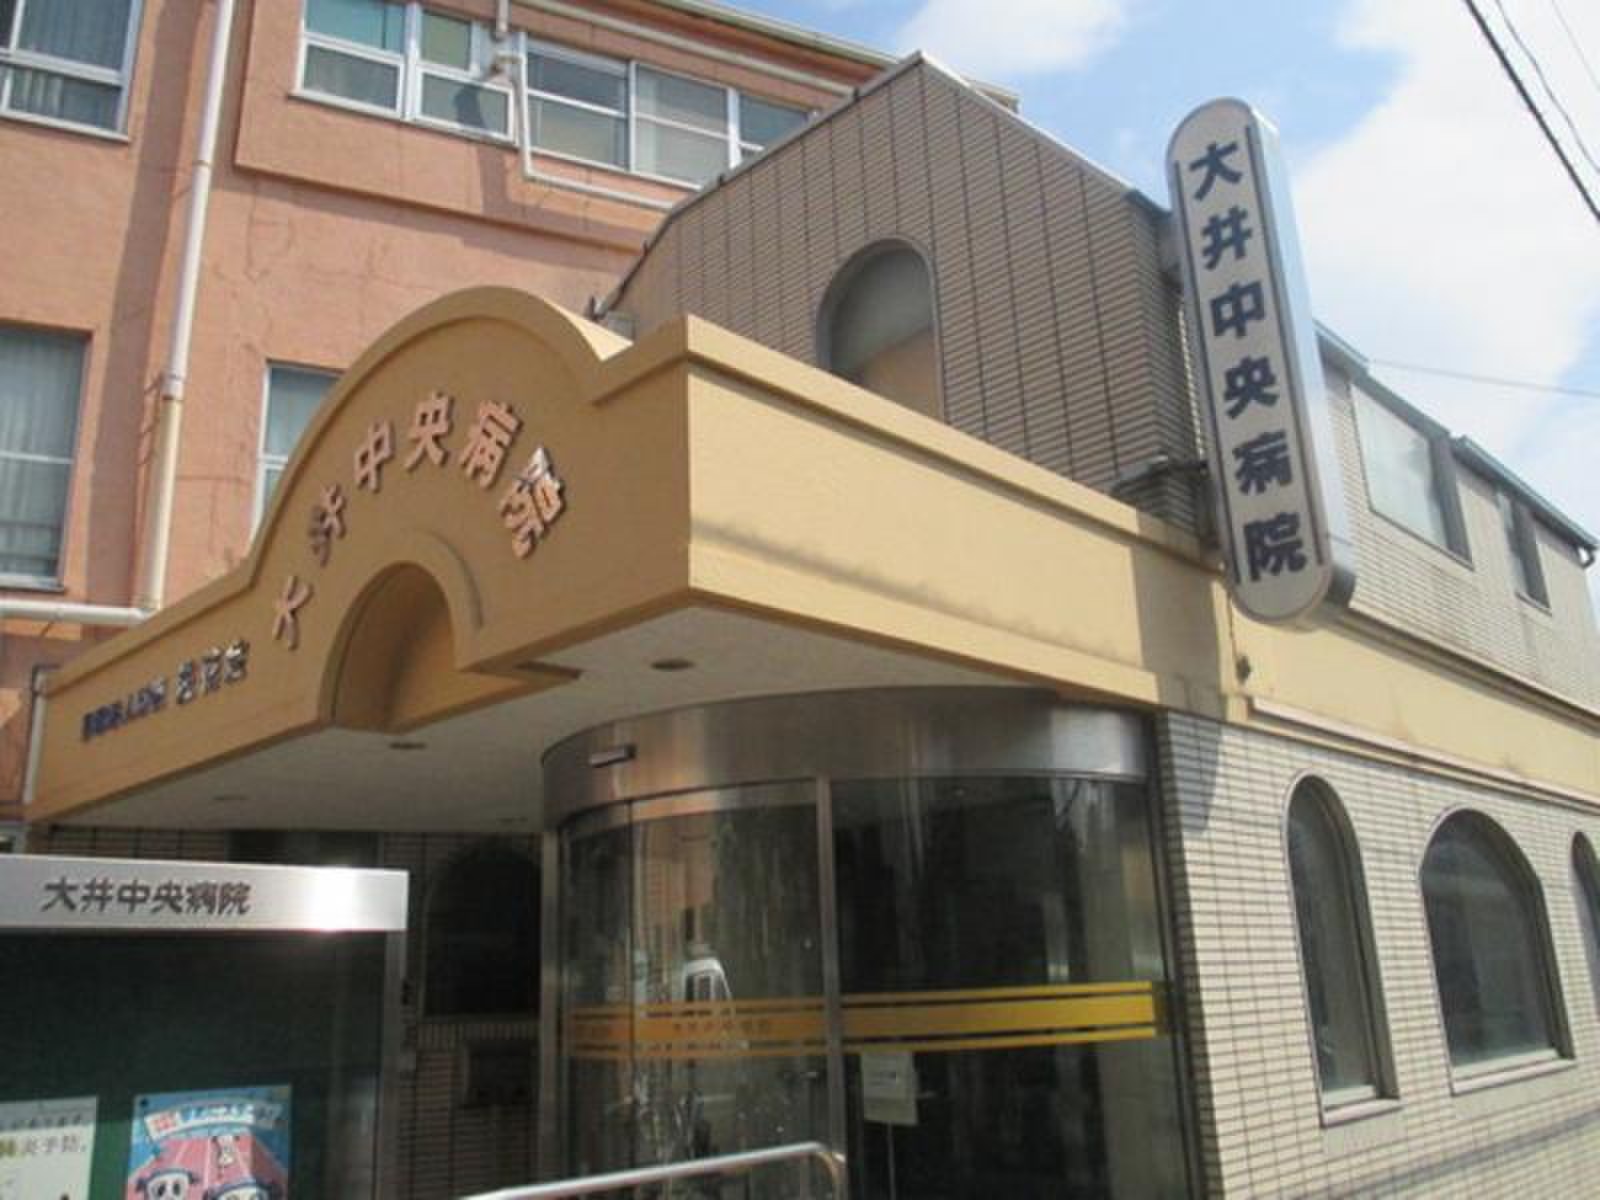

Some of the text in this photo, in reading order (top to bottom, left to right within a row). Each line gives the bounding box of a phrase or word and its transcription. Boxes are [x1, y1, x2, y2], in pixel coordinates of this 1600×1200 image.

[1190, 142, 1307, 580] 大井中央病院
[272, 391, 565, 650] 大井中央病院
[42, 877, 252, 916] 大井中央病院
